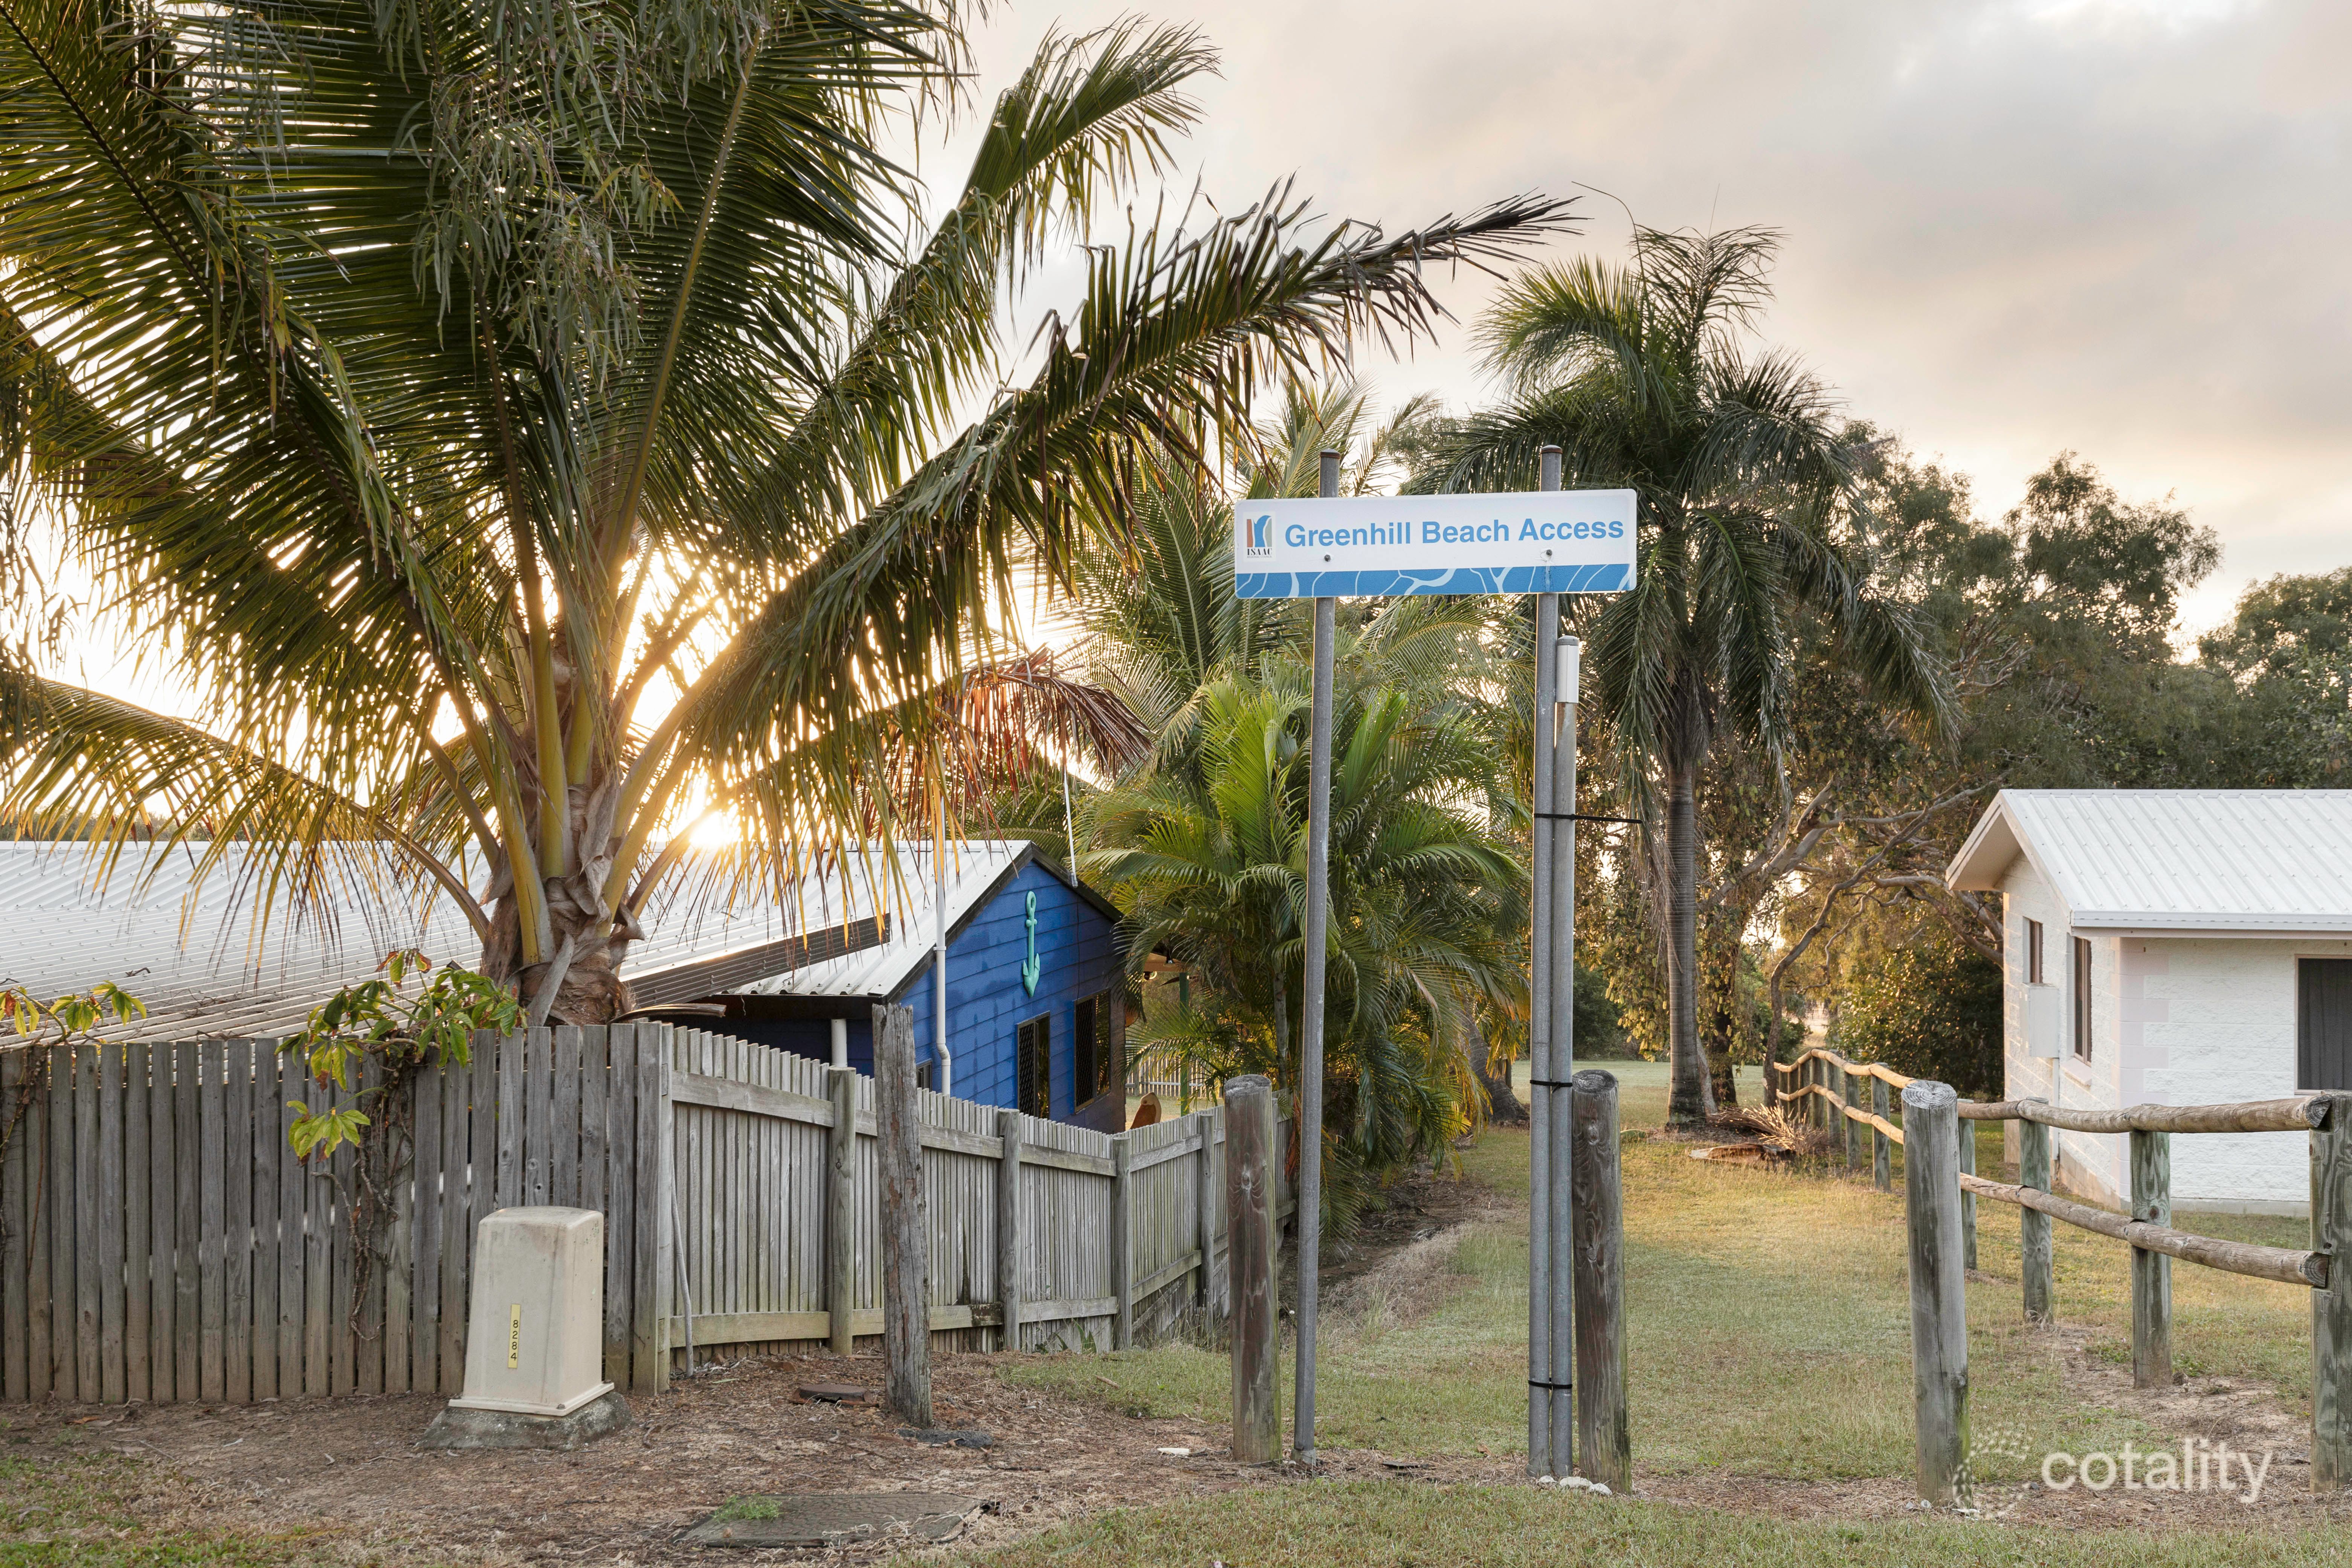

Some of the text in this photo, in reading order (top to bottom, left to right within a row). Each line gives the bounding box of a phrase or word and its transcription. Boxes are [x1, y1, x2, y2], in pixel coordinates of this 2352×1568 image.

[1285, 518, 1623, 547] Greenhill Beach Access
[510, 1319, 519, 1360] 8284
